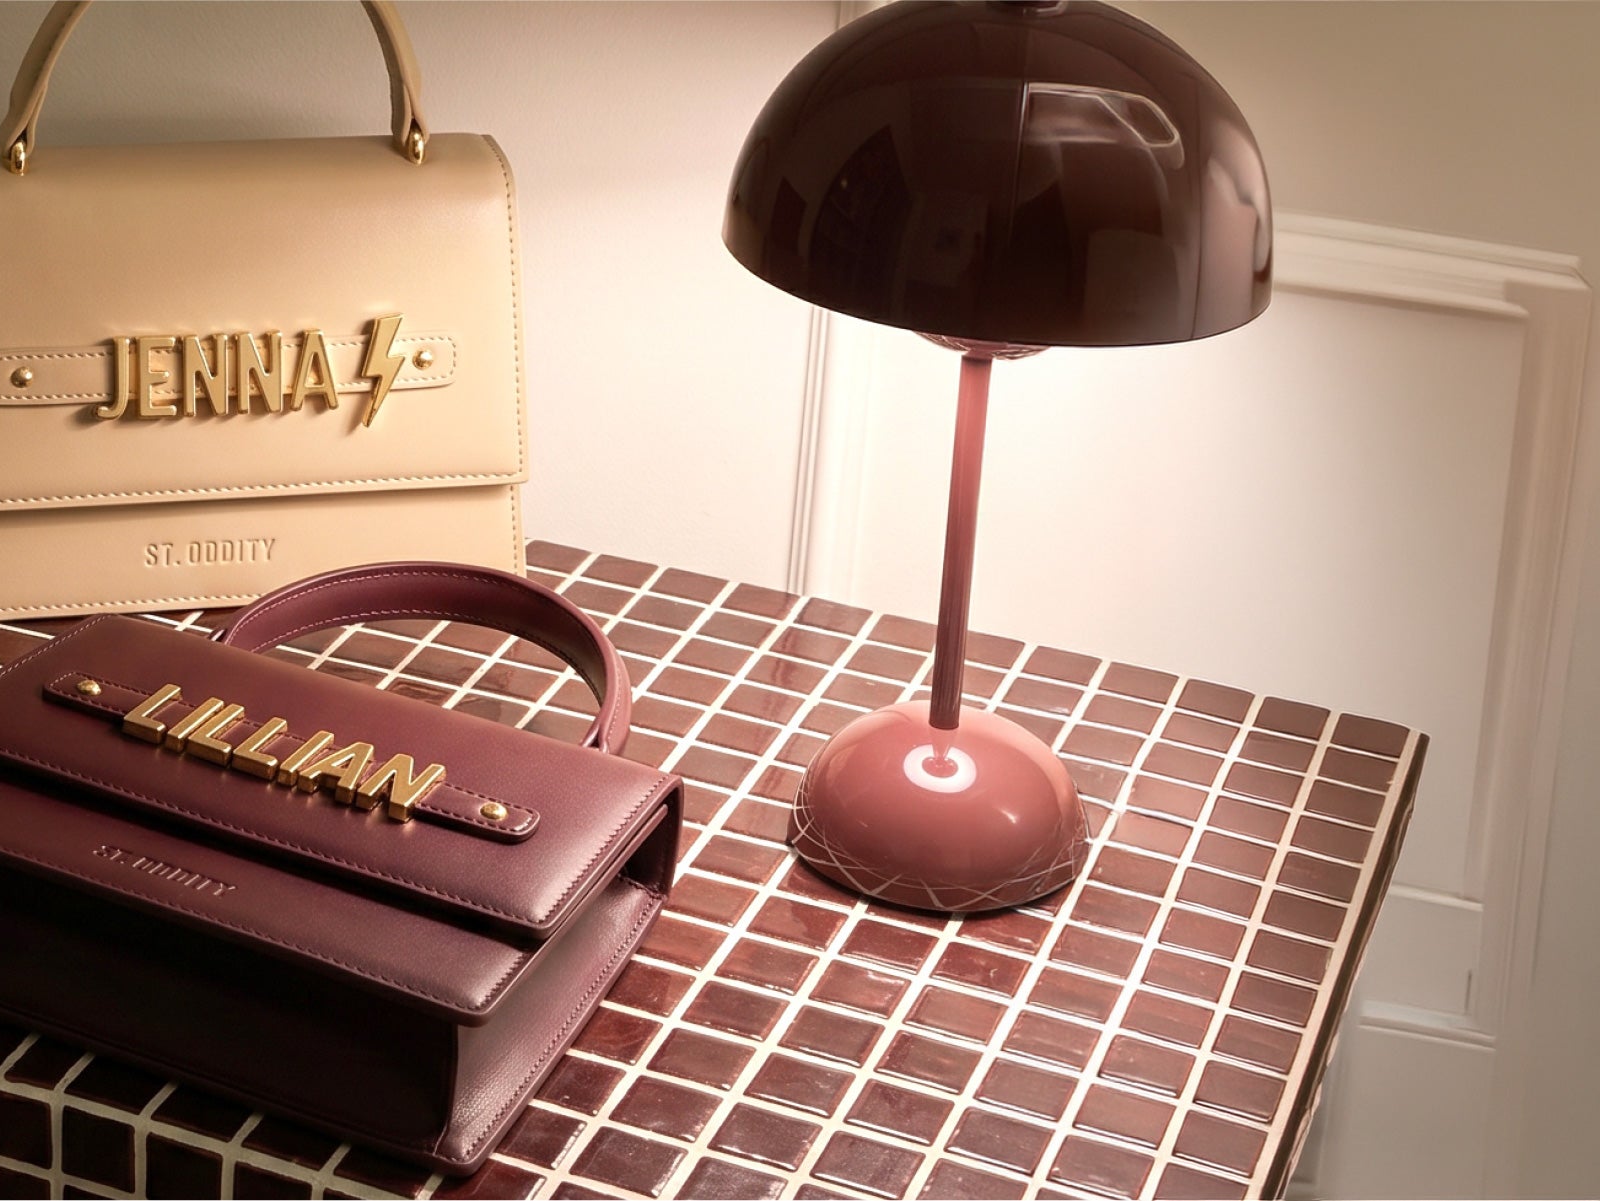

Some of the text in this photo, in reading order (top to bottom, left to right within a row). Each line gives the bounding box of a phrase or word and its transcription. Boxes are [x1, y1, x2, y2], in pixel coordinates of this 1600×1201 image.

[94, 328, 340, 421] JENNA
[144, 537, 276, 568] ST. ODDITY
[122, 683, 447, 823] LILLIAN
[92, 844, 237, 898] ST. ODDITY
